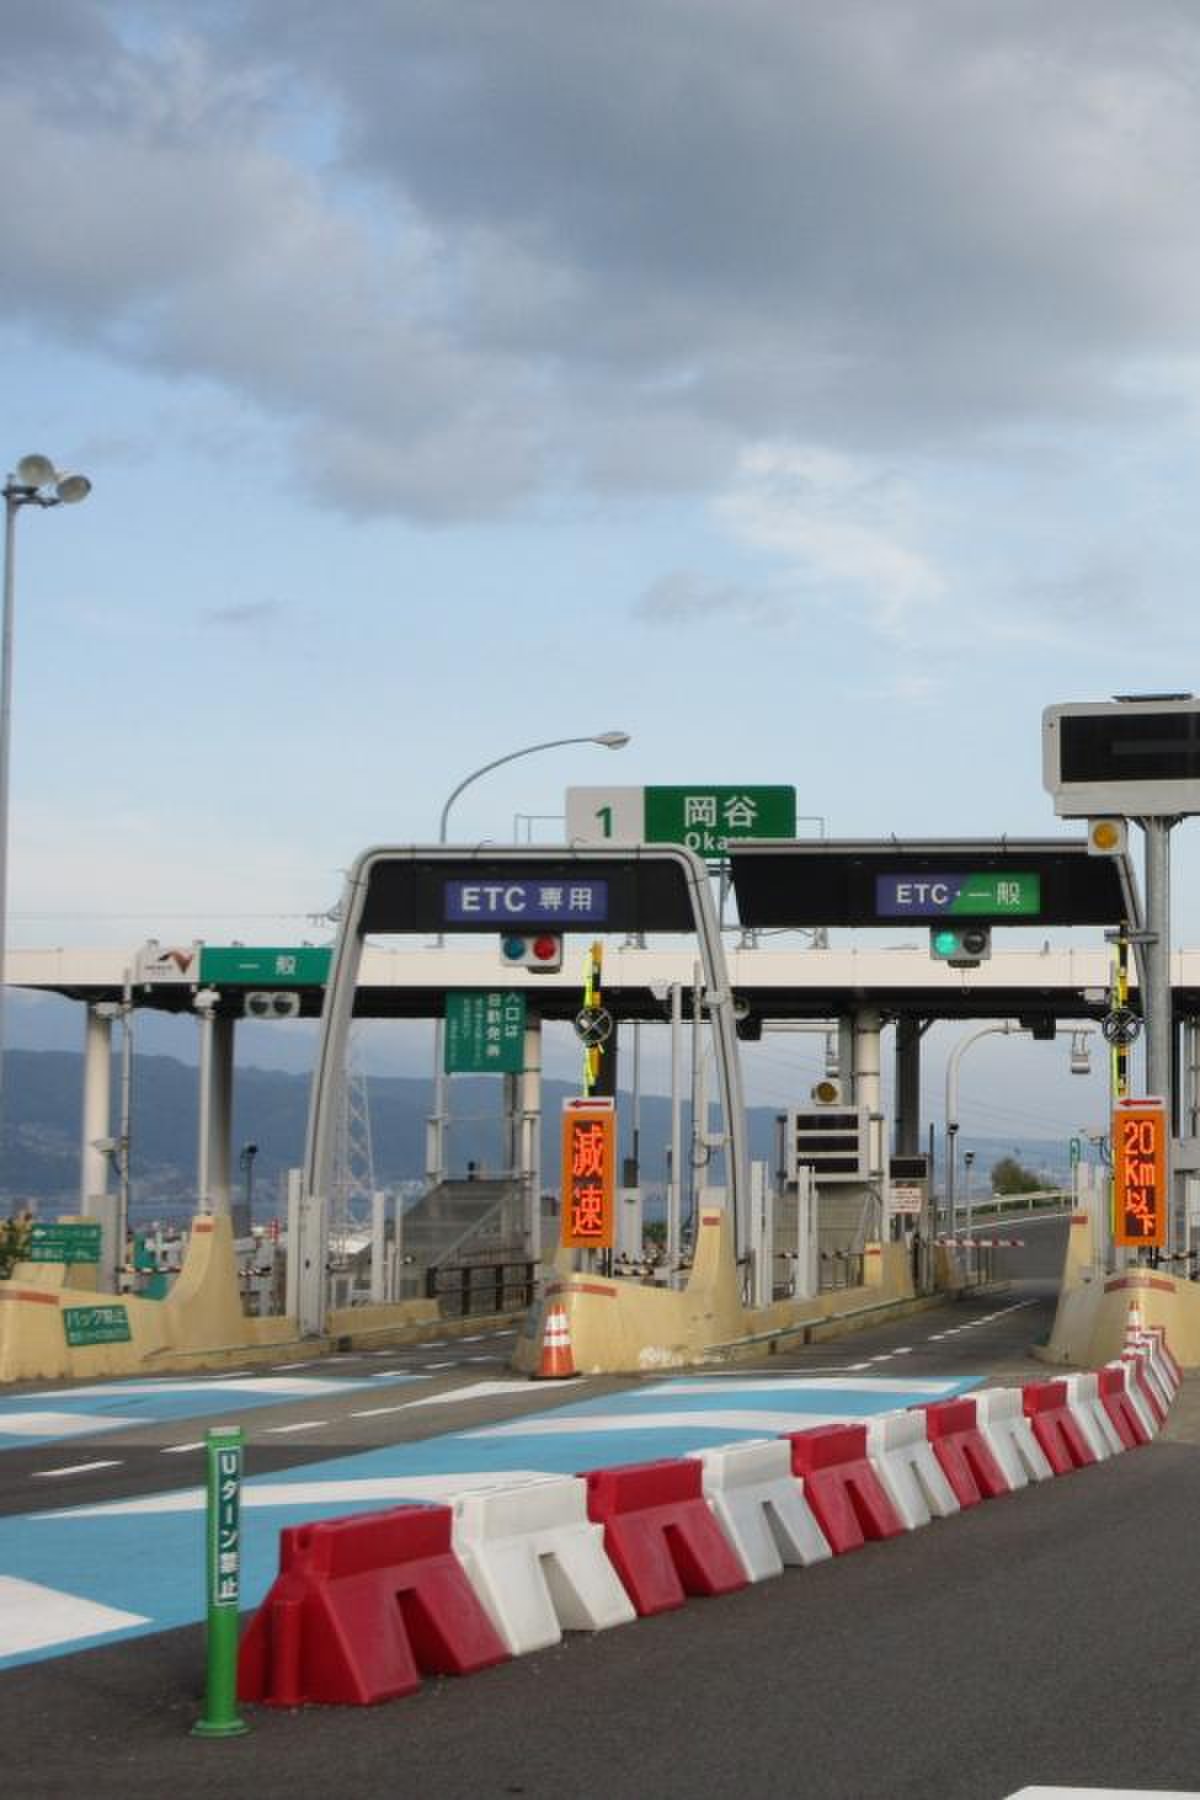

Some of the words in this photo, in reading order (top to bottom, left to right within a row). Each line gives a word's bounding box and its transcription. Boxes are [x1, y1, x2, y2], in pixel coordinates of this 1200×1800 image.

[596, 806, 613, 839] 1
[684, 796, 758, 828] 岡谷
[461, 887, 527, 912] ETC
[538, 887, 592, 911] 専用
[239, 955, 296, 976] 一般
[1125, 1121, 1155, 1155] 20
[573, 1123, 603, 1235] 減速
[1125, 1187, 1155, 1236] 以下
[220, 1453, 239, 1598] Uターン禁止
